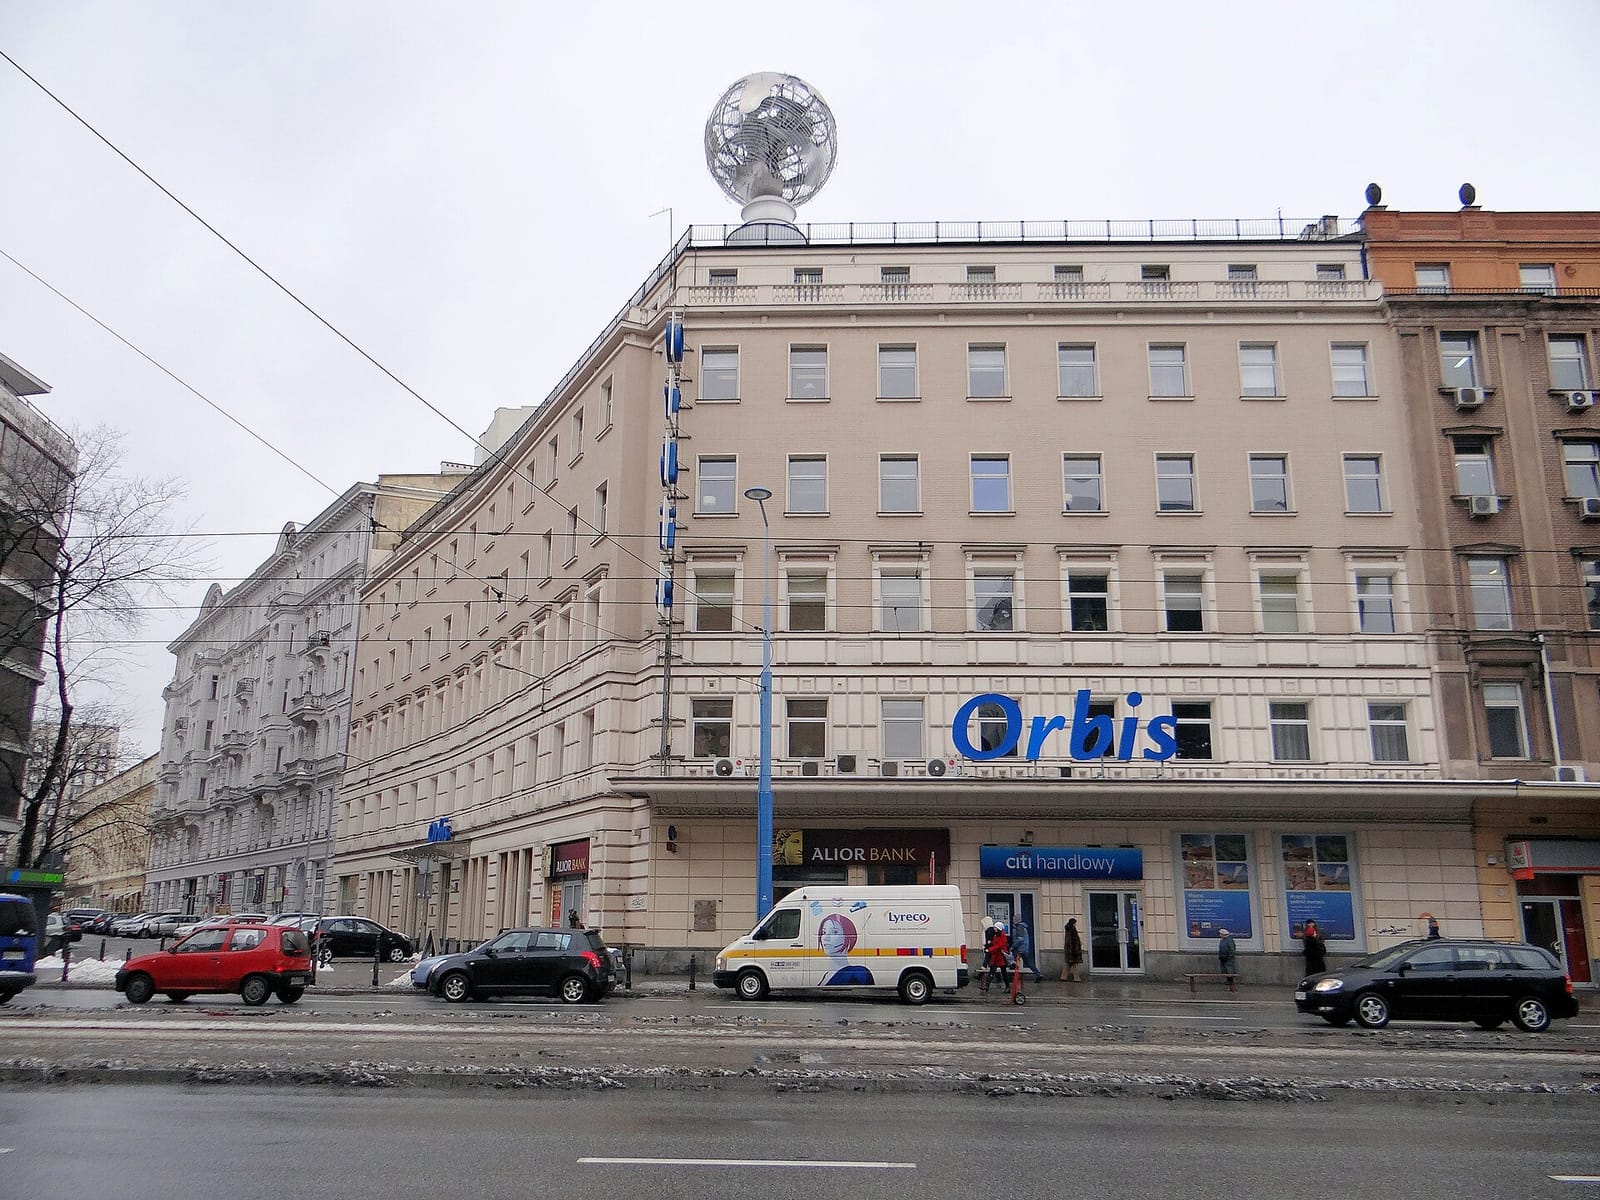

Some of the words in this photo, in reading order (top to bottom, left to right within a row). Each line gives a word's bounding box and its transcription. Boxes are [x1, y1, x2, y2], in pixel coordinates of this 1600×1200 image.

[952, 689, 1178, 761] Orbis
[811, 847, 866, 861] ALIOR
[870, 847, 916, 861] BANK
[556, 860, 572, 873] ALIOR
[572, 857, 586, 871] BANK
[1005, 854, 1032, 869] citi
[1036, 854, 1115, 874] handlowy
[889, 911, 927, 924] Lyreco
